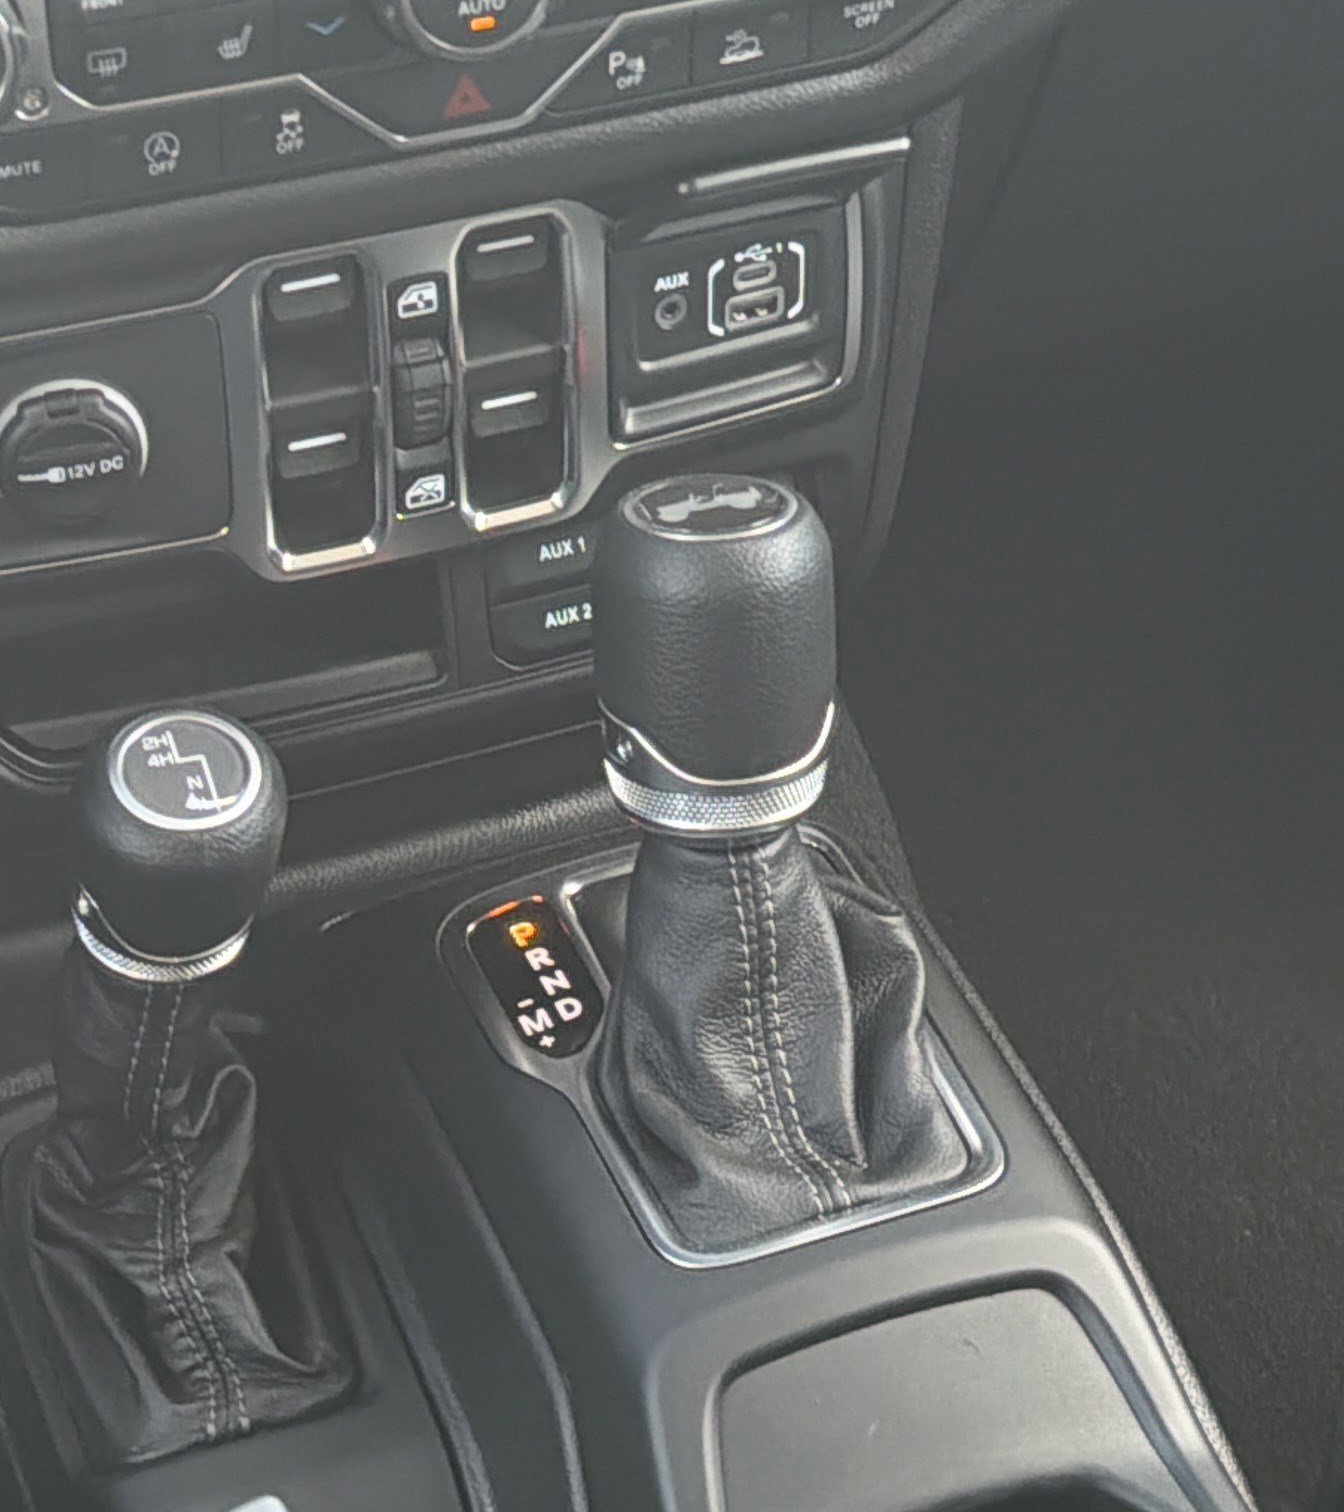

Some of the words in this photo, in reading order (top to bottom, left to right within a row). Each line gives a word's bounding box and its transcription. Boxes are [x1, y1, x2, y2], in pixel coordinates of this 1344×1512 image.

[854, 12, 881, 30] OFF
[615, 72, 644, 91] OFF
[275, 136, 305, 155] OFF
[147, 158, 178, 177] OFF
[654, 271, 690, 293] AUX
[67, 460, 96, 481] 12V
[99, 454, 124, 475] DC
[538, 538, 575, 563] AUX
[577, 535, 587, 554] 1
[544, 605, 580, 629] AUX
[582, 602, 593, 620] 2
[141, 733, 168, 752] 2H
[146, 751, 175, 769] 4H
[186, 774, 205, 791] N
[509, 921, 538, 949] P
[524, 946, 556, 972] R
[539, 969, 572, 997] N
[554, 996, 584, 1022] D
[517, 1007, 555, 1037] M
